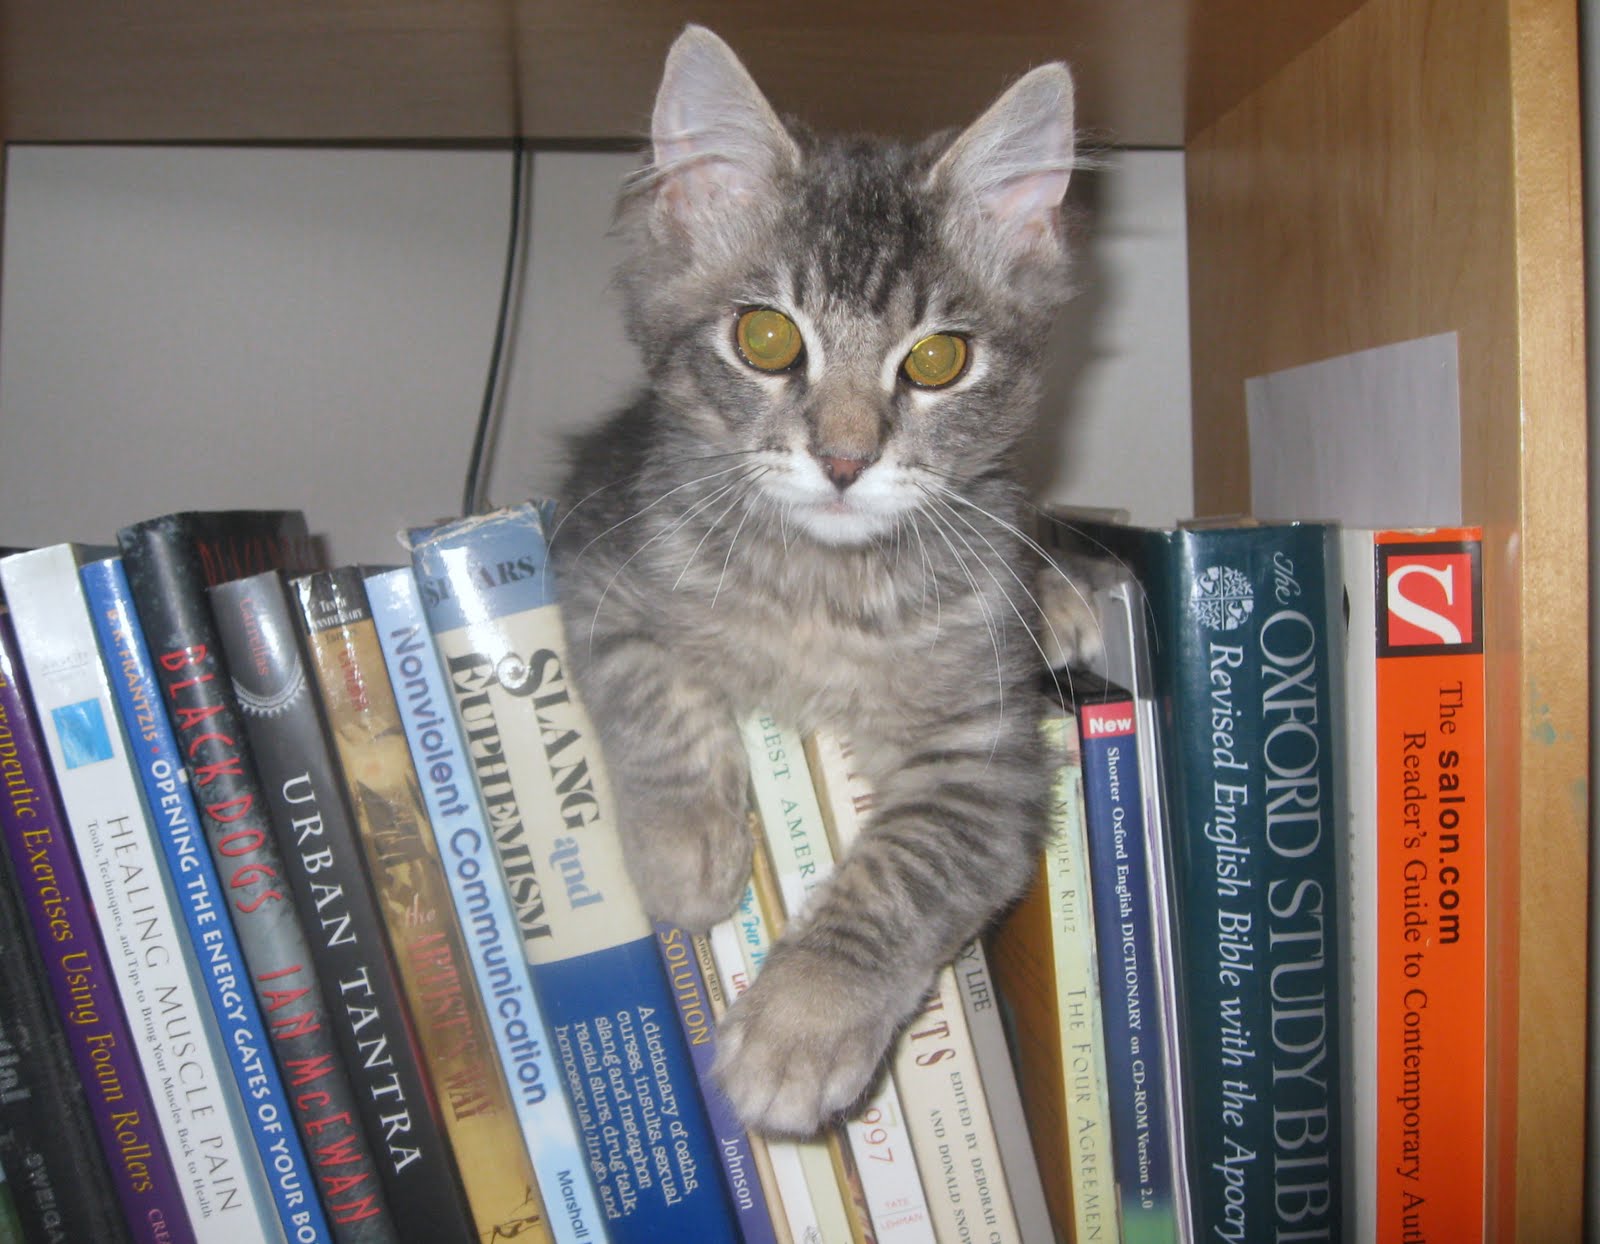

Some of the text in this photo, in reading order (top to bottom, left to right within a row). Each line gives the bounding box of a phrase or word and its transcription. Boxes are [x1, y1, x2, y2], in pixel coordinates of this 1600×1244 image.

[422, 556, 536, 608] SARS
[1273, 550, 1301, 605] The
[119, 650, 158, 742] FRANTZIS
[1089, 717, 1132, 734] New
[1209, 641, 1249, 770] Revised
[1259, 609, 1322, 858] OXFORD
[496, 648, 605, 910] SLANG and
[759, 716, 791, 782] BEST
[1403, 730, 1427, 849] Reader's
[151, 759, 199, 872] OPENING
[447, 652, 553, 941] EUPHEMISM
[1204, 780, 1251, 898] English
[1438, 681, 1465, 945] The salon.com
[160, 644, 243, 787] BLACK
[207, 794, 284, 913] DOGS
[257, 965, 321, 1041] IAN
[390, 622, 547, 1106] Nonviolent Communication
[187, 873, 217, 925] THE
[405, 893, 436, 927] the
[1061, 889, 1075, 933] RUIZ
[1403, 858, 1429, 943] Guide
[202, 929, 247, 1023] ENERGY
[282, 772, 357, 947] URBAN
[338, 966, 422, 1174] TANTRA
[661, 928, 711, 1045] SOLUTION
[965, 969, 991, 1012] LIFE
[1107, 747, 1153, 1209] Shorter Oxford English DICTIONARY on CD-ROM Version 2.0
[1218, 908, 1254, 987] Bible
[1267, 878, 1328, 1093] STUDY
[1403, 953, 1425, 979] to
[22, 827, 75, 942] Exercises
[60, 950, 100, 1026] Using
[86, 1032, 124, 1102] Foam
[111, 1109, 153, 1193] Rollers
[87, 819, 211, 1219] Tools, Techniques, and Tips to Bring Your Muscles Back to Health
[107, 816, 242, 1213] HEALING MUSCLE PAIN
[1068, 987, 1087, 1031] THE
[1220, 997, 1256, 1067] with
[234, 1028, 271, 1100] GATES
[595, 1016, 621, 1065] slang
[608, 1067, 633, 1103] and
[638, 1005, 699, 1195] A dictionary of oaths,
[950, 1071, 972, 1127] EDITED
[1071, 1041, 1092, 1103] FOUR
[1223, 1079, 1257, 1128] the
[1396, 988, 1428, 1182] Contemporary
[258, 1103, 283, 1134] OF
[555, 1025, 596, 1130] homosexual
[600, 1185, 621, 1220] and
[575, 1021, 637, 1216] racial slurs, drug talk,
[616, 1010, 682, 1207] curses, insults, sexual
[965, 1132, 979, 1150] BY
[270, 1138, 304, 1208] YOUR
[721, 1137, 754, 1210] Johnson
[930, 1108, 945, 1138] AND
[938, 1143, 961, 1204] DONALD
[970, 1157, 997, 1226] DEBORAH
[291, 1211, 317, 1244] BO
[556, 1168, 590, 1239] Marshall
